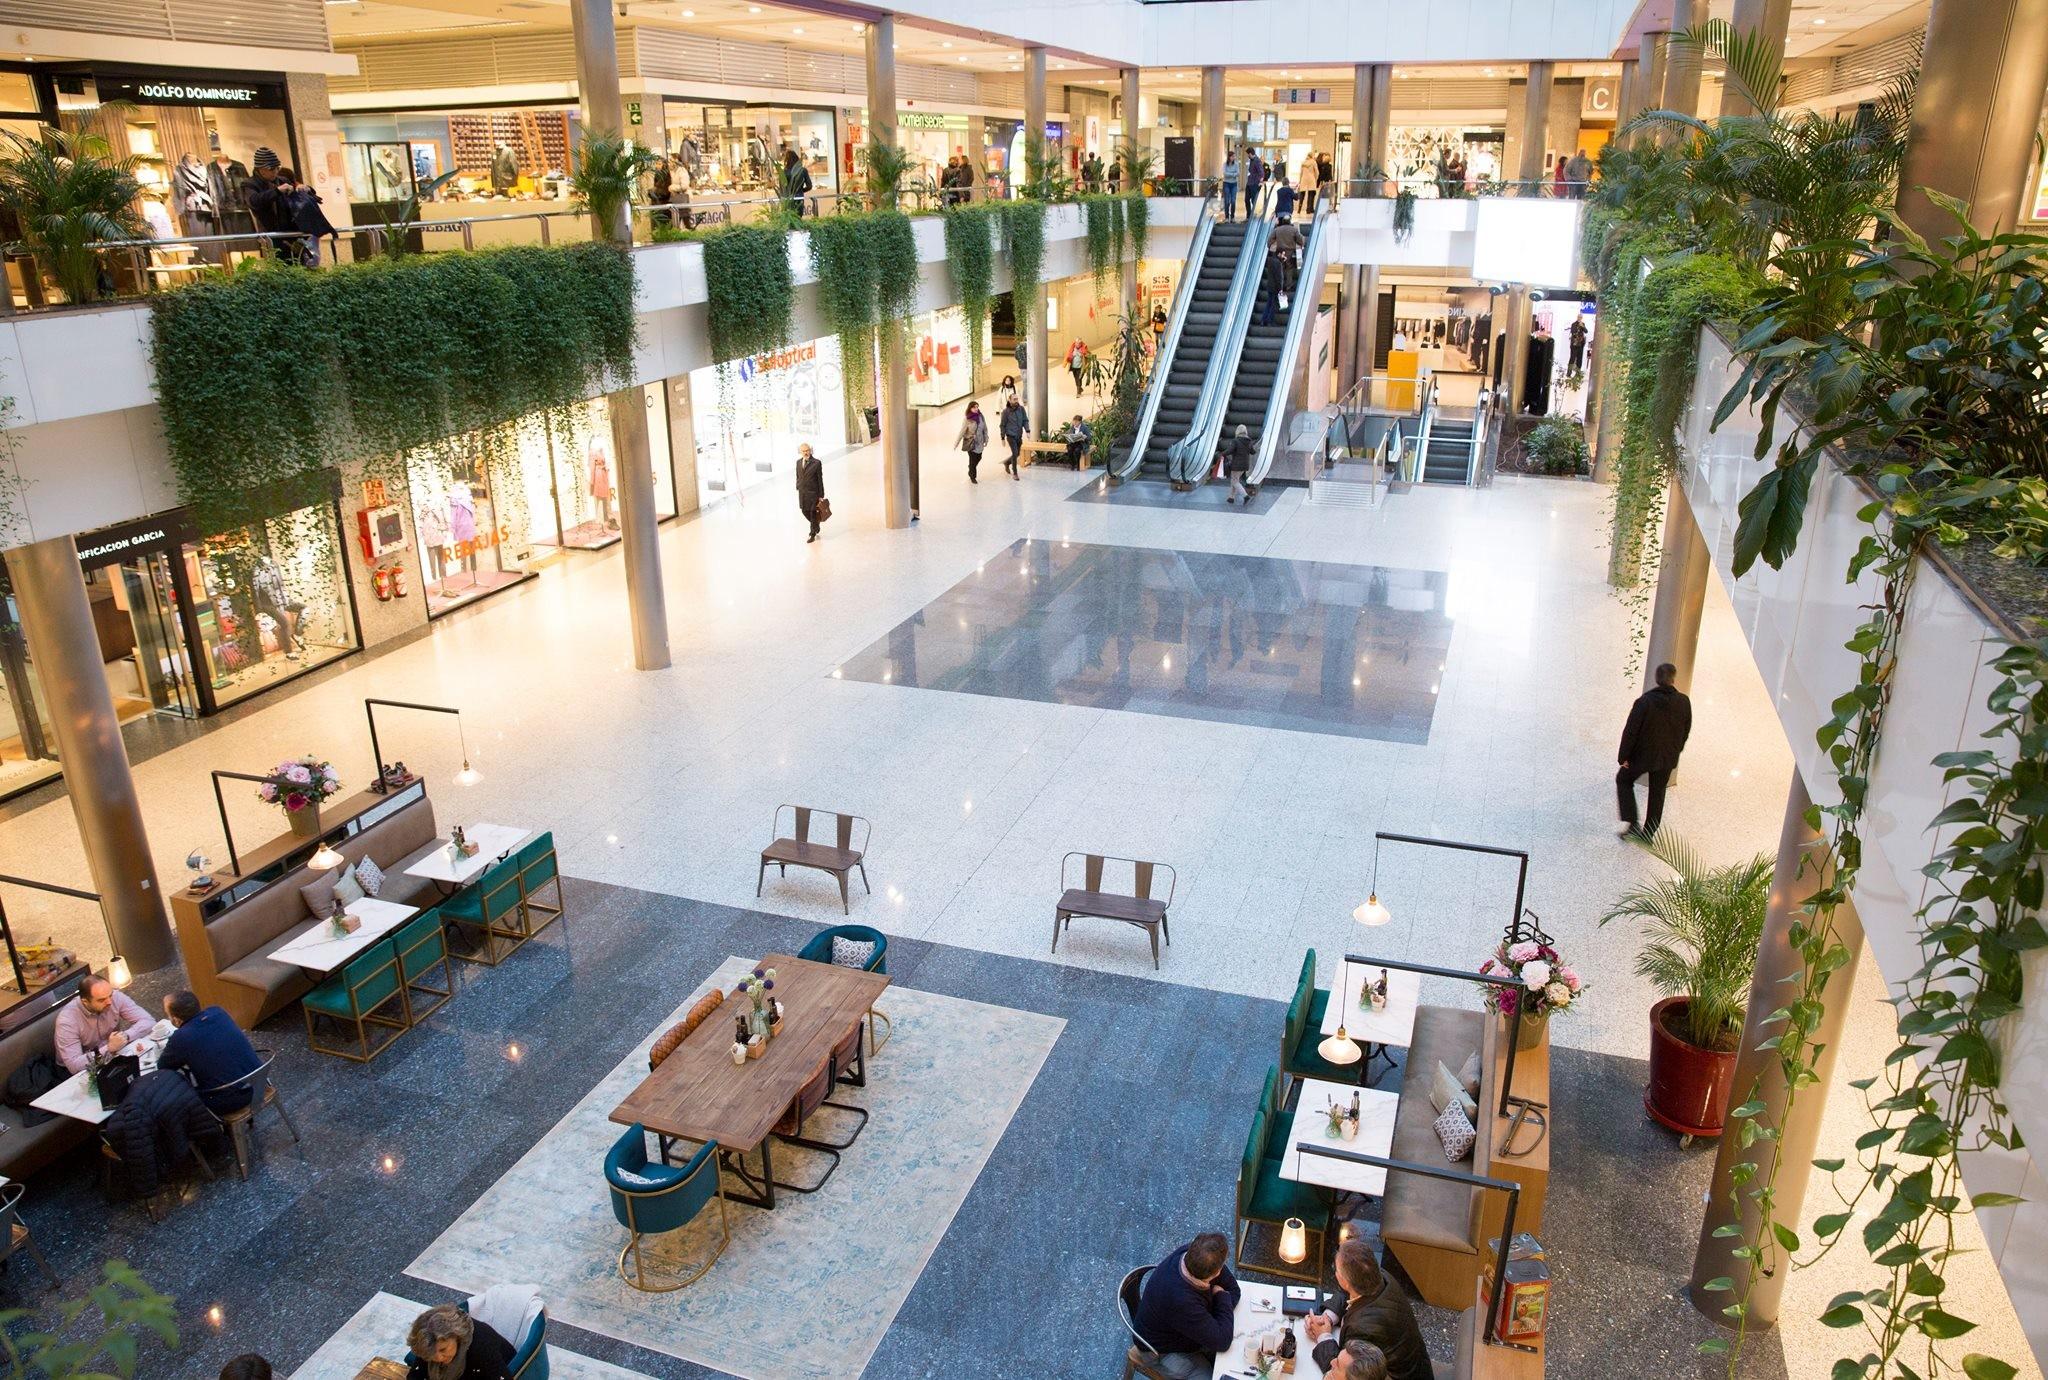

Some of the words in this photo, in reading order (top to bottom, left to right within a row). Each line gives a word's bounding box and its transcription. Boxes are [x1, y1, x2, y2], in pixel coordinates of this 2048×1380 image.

[138, 85, 184, 98] ADOLFO
[185, 87, 252, 101] DOMINGUEZ
[1592, 87, 1610, 110] C
[131, 529, 165, 545] GARCIA
[441, 525, 510, 563] REBAJAS
